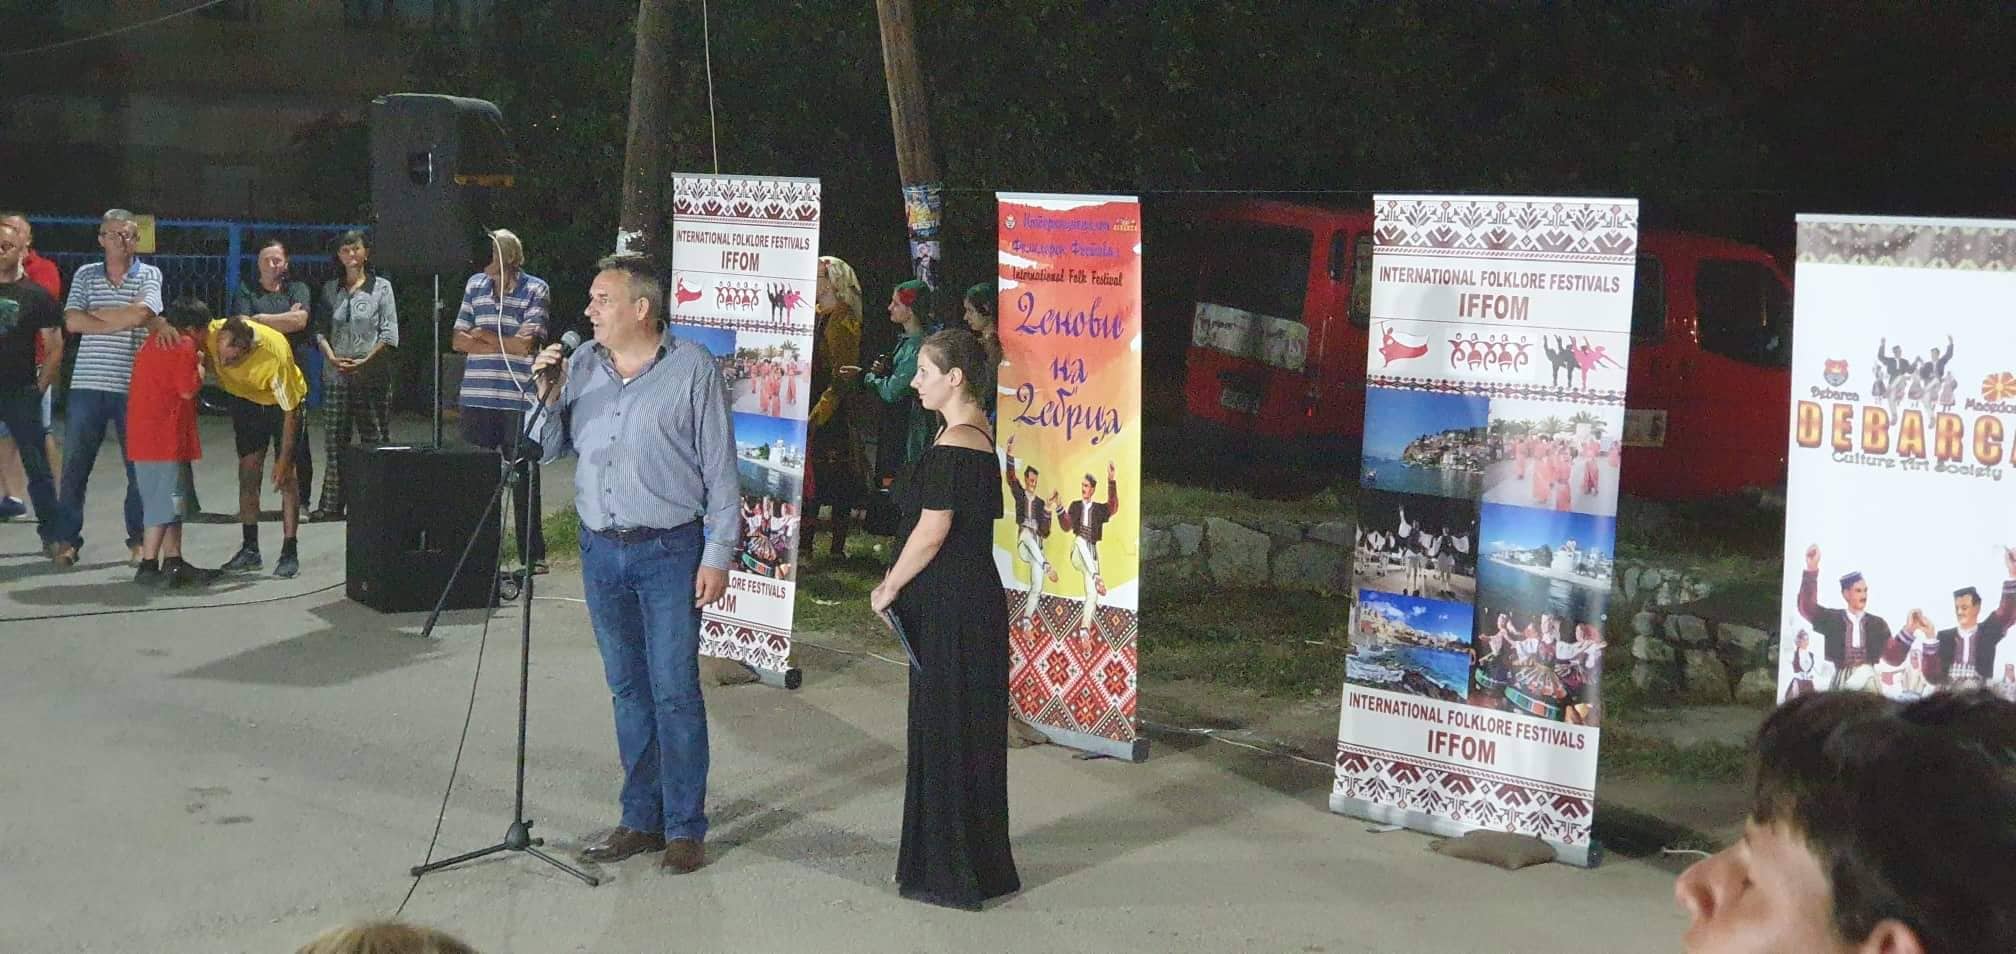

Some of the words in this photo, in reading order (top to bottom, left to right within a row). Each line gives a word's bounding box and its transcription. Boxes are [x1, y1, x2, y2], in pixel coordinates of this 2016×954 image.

[676, 230, 731, 245] INTERNATIONAL
[732, 233, 769, 248] FOLKLORE
[771, 236, 810, 250] FESTIVALS
[721, 251, 760, 272] IFFOM
[1012, 266, 1064, 282] International
[1068, 269, 1087, 284] Folk
[1091, 270, 1123, 286] Festival
[1379, 266, 1476, 286] INTERNATIONAL
[1480, 270, 1546, 289] FOLKLORE
[1549, 273, 1620, 293] FESTIVALS
[1458, 293, 1530, 321] IFFOM
[1050, 355, 1088, 384] на
[1964, 397, 2016, 414] Macedo
[1796, 400, 2016, 468] DEBARC
[1832, 451, 1896, 469] Culture
[747, 580, 786, 599] FESTIVALS
[1349, 692, 1443, 724] INTERNATIONAL
[1447, 709, 1512, 737] FOLKLORE
[1515, 722, 1585, 750] FESTIVALS
[1427, 729, 1496, 765] IFFOM
